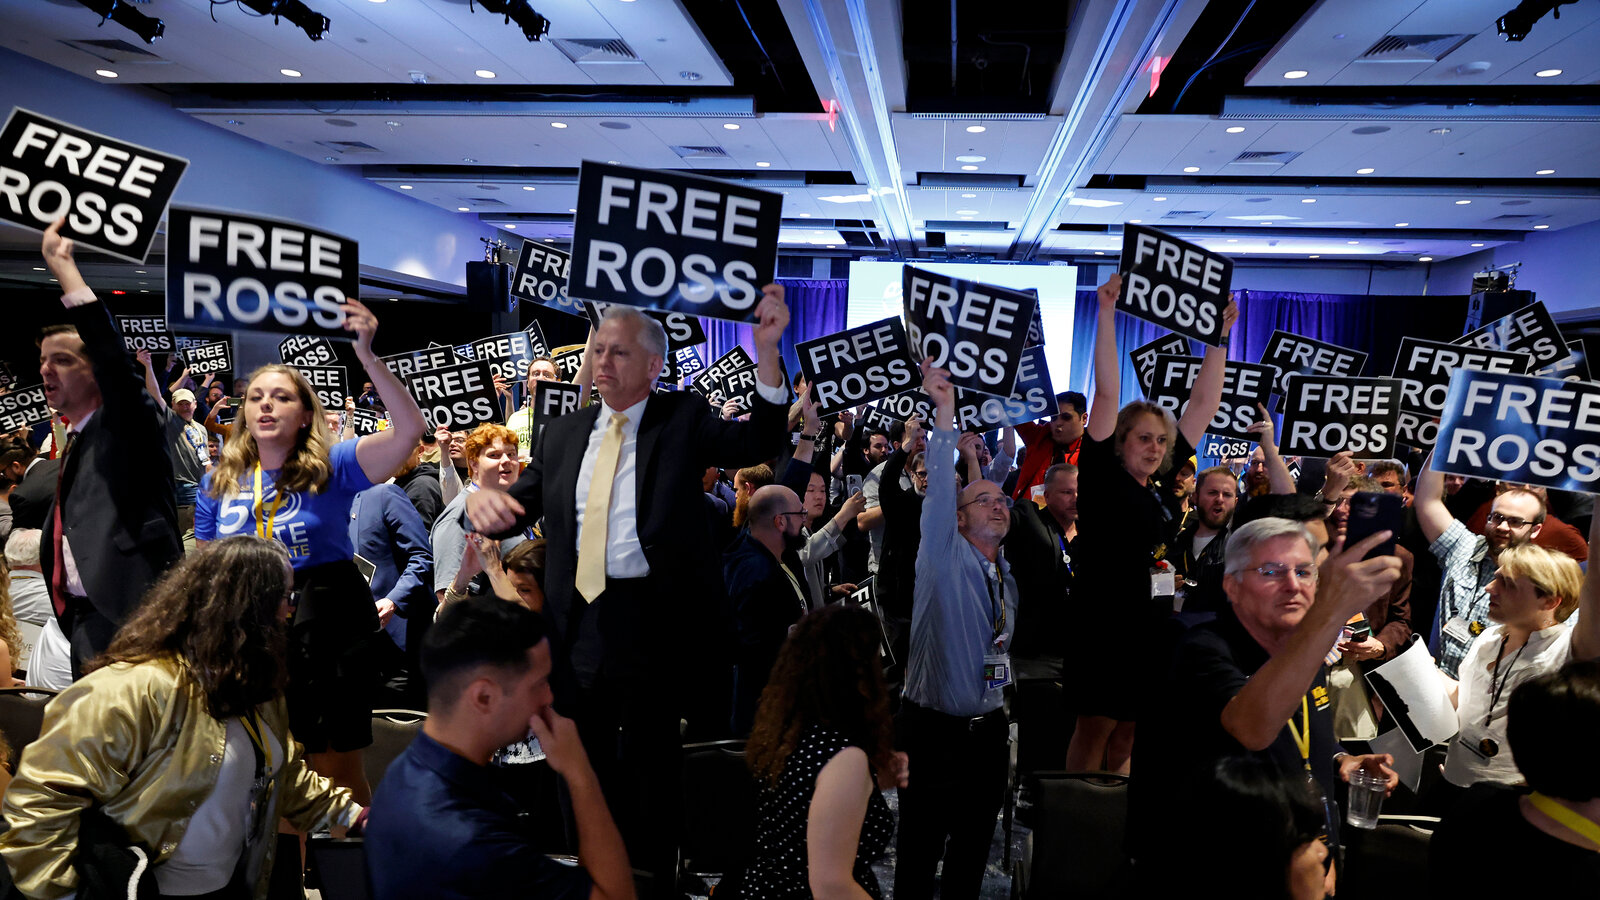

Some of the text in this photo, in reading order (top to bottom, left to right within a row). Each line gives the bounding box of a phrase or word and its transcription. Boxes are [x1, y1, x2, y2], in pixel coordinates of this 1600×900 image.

[12, 122, 165, 198] FREE
[0, 166, 144, 246] ROSS
[598, 175, 761, 248] FREE
[189, 216, 343, 279] FREE
[1134, 232, 1224, 295] FREE
[585, 239, 757, 310] ROSS
[183, 272, 346, 328] ROSS
[910, 276, 1019, 339] FREE
[1125, 273, 1218, 335] ROSS
[121, 319, 166, 333] FREE
[124, 336, 171, 350] ROSS
[1460, 310, 1544, 350] REE
[187, 345, 224, 361] FREE
[190, 358, 227, 374] ROSS
[285, 345, 330, 366] OSS
[476, 336, 526, 360] FREE
[808, 324, 898, 374] FREE
[908, 321, 1008, 385] ROSS
[1273, 337, 1355, 377] FREE
[299, 369, 341, 387] REE
[412, 367, 484, 401] FREE
[490, 360, 531, 379] OSS
[677, 358, 701, 378] OSS
[699, 351, 746, 391] FREE
[816, 359, 911, 409] ROSS
[317, 390, 343, 407] SS
[421, 397, 494, 430] ROSS
[959, 387, 1047, 431] ROSS
[1299, 383, 1392, 415] FREE
[1400, 379, 1448, 410] RO
[1463, 380, 1600, 433] FREE
[0, 405, 52, 430] FREE
[1156, 395, 1256, 433] RSS
[1395, 413, 1439, 445] RO
[1207, 442, 1248, 456] ROSS
[1290, 421, 1388, 453] ROSS
[1447, 428, 1600, 483] ROSS
